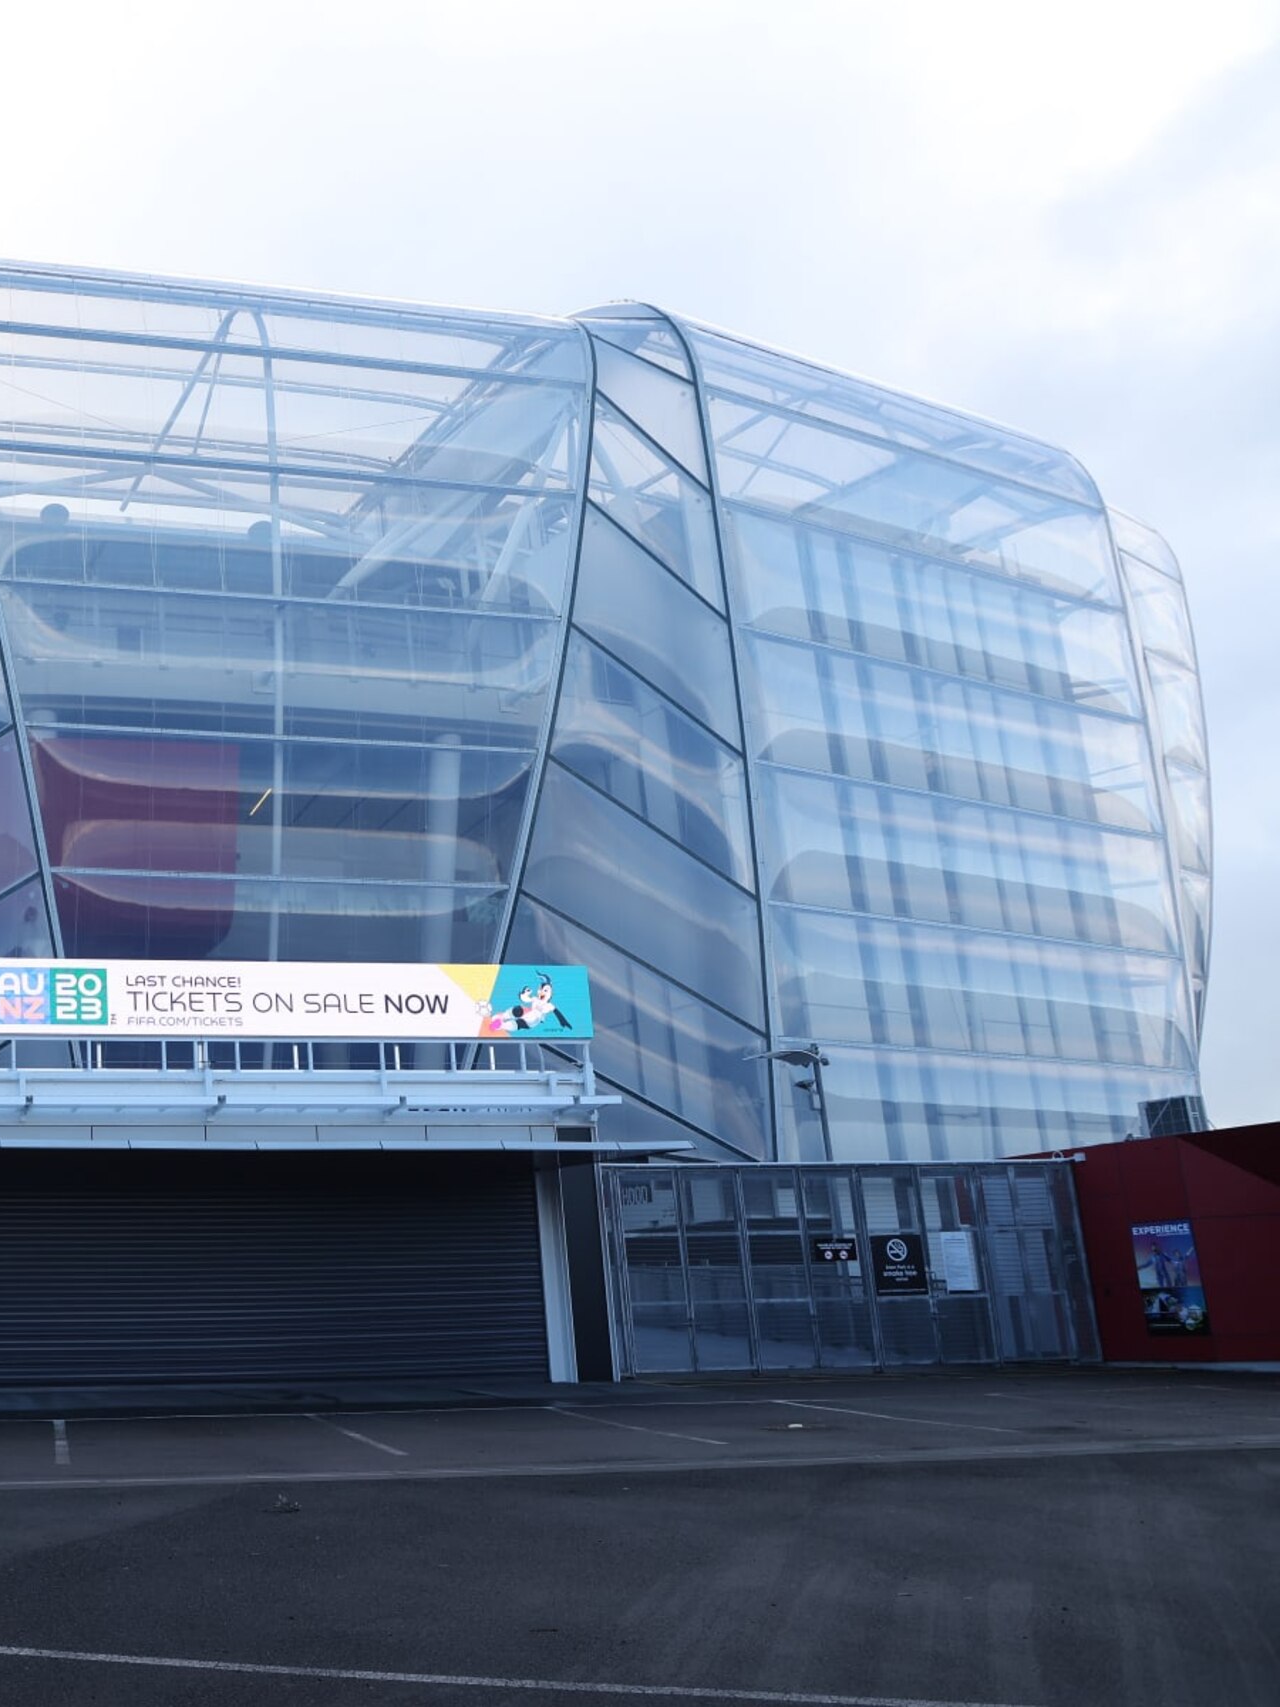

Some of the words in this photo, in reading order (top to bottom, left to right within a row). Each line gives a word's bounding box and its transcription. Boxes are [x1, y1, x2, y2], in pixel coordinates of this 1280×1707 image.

[55, 973, 102, 996] 20
[126, 975, 167, 987] LAST
[171, 976, 242, 988] CHANCE!
[55, 997, 103, 1020] 23
[126, 991, 243, 1012] TICKETS
[253, 992, 293, 1013] ON
[303, 993, 375, 1014] SALE
[384, 994, 449, 1014] NOW
[1131, 1222, 1191, 1236] EXPERIENCE
